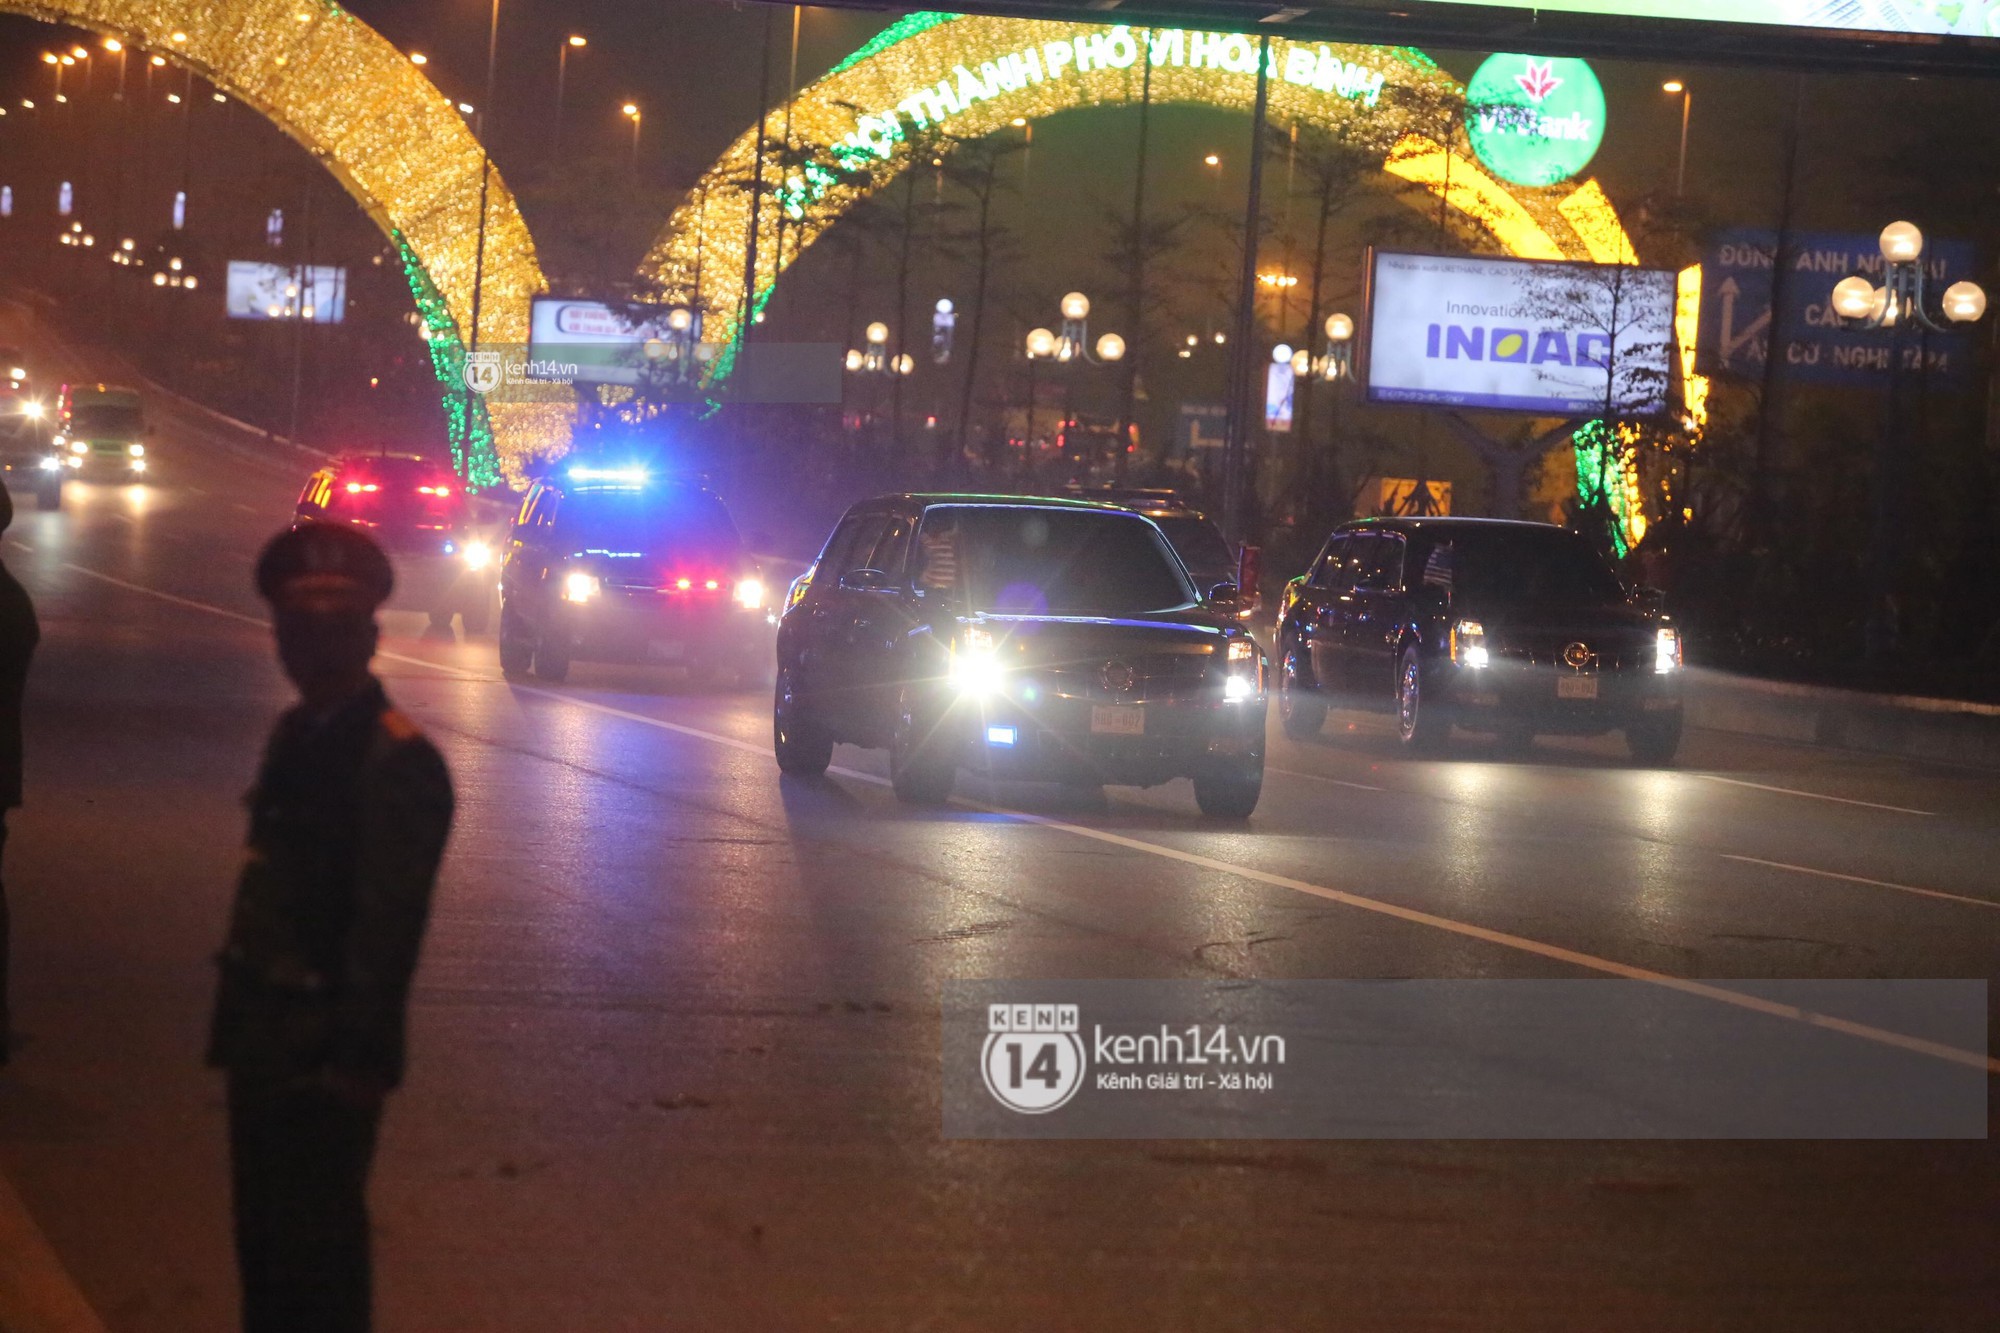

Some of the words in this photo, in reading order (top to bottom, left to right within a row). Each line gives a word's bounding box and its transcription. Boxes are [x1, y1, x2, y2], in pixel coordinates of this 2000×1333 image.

[897, 46, 1045, 130] THÀNH
[1795, 249, 1849, 273] ANH
[1446, 300, 1528, 319] Innovation
[1425, 323, 1611, 368] INOAC
